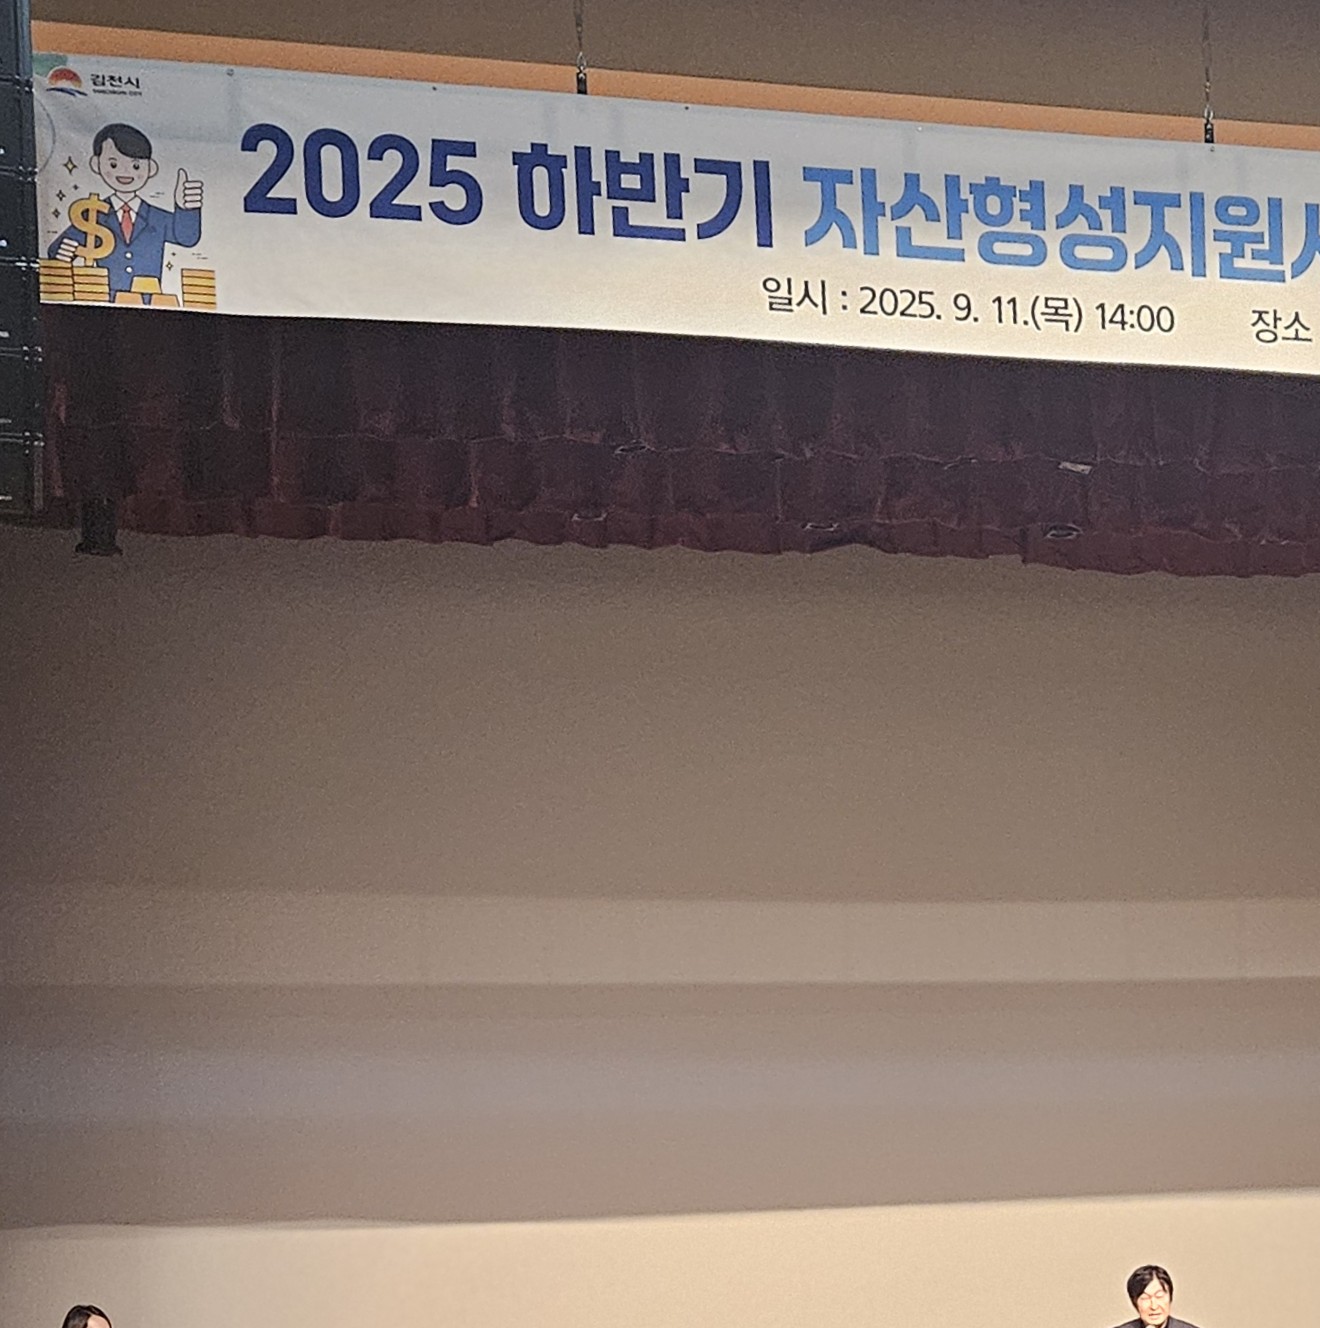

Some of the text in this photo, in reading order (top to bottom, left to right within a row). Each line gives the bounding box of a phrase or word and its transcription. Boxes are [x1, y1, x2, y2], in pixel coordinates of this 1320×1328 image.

[90, 73, 141, 89] 김천시
[240, 122, 484, 226] 2025
[511, 141, 774, 249] 하반기
[762, 277, 828, 316] 일시
[859, 286, 942, 320] 2025.
[953, 293, 979, 323] 9.
[991, 295, 1083, 333] 11.(목)
[1095, 302, 1175, 333] 14:00
[1251, 308, 1313, 344] 장소
